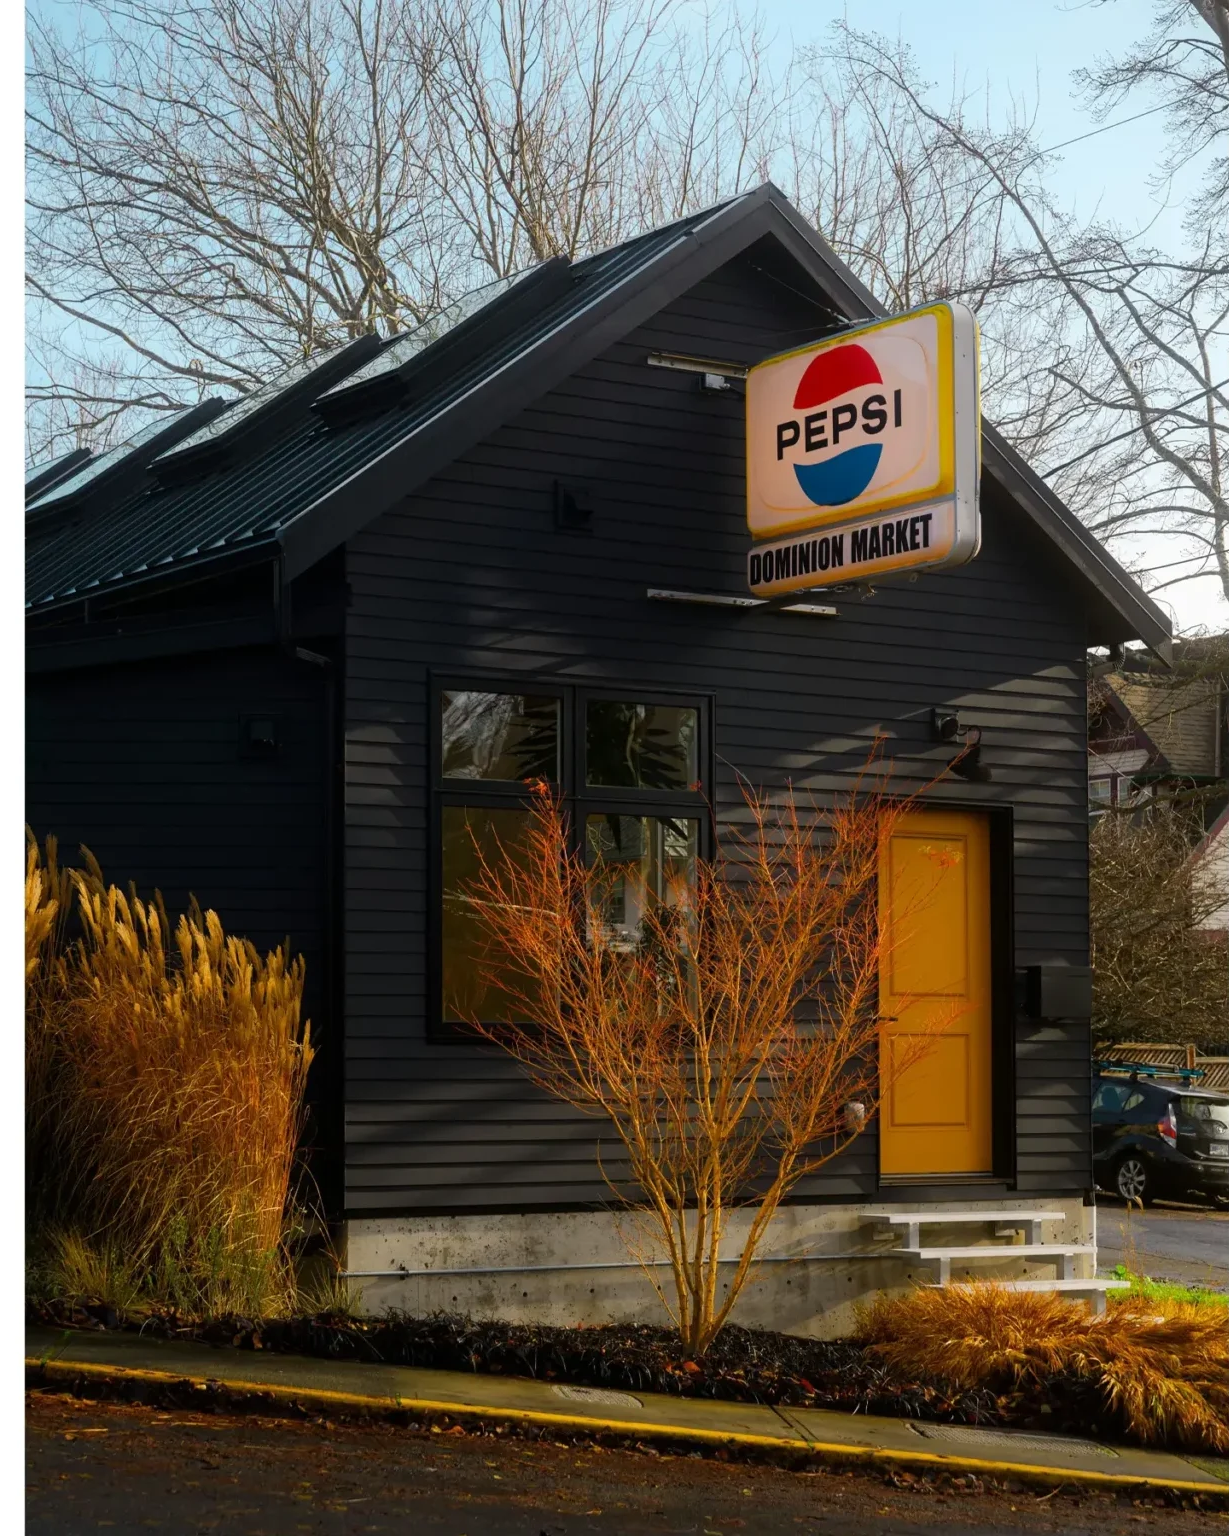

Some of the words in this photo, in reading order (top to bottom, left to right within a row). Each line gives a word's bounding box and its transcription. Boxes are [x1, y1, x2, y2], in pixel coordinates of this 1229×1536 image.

[776, 388, 902, 461] PEPSI
[749, 534, 844, 586] DOMINION
[851, 513, 933, 563] MARKET
